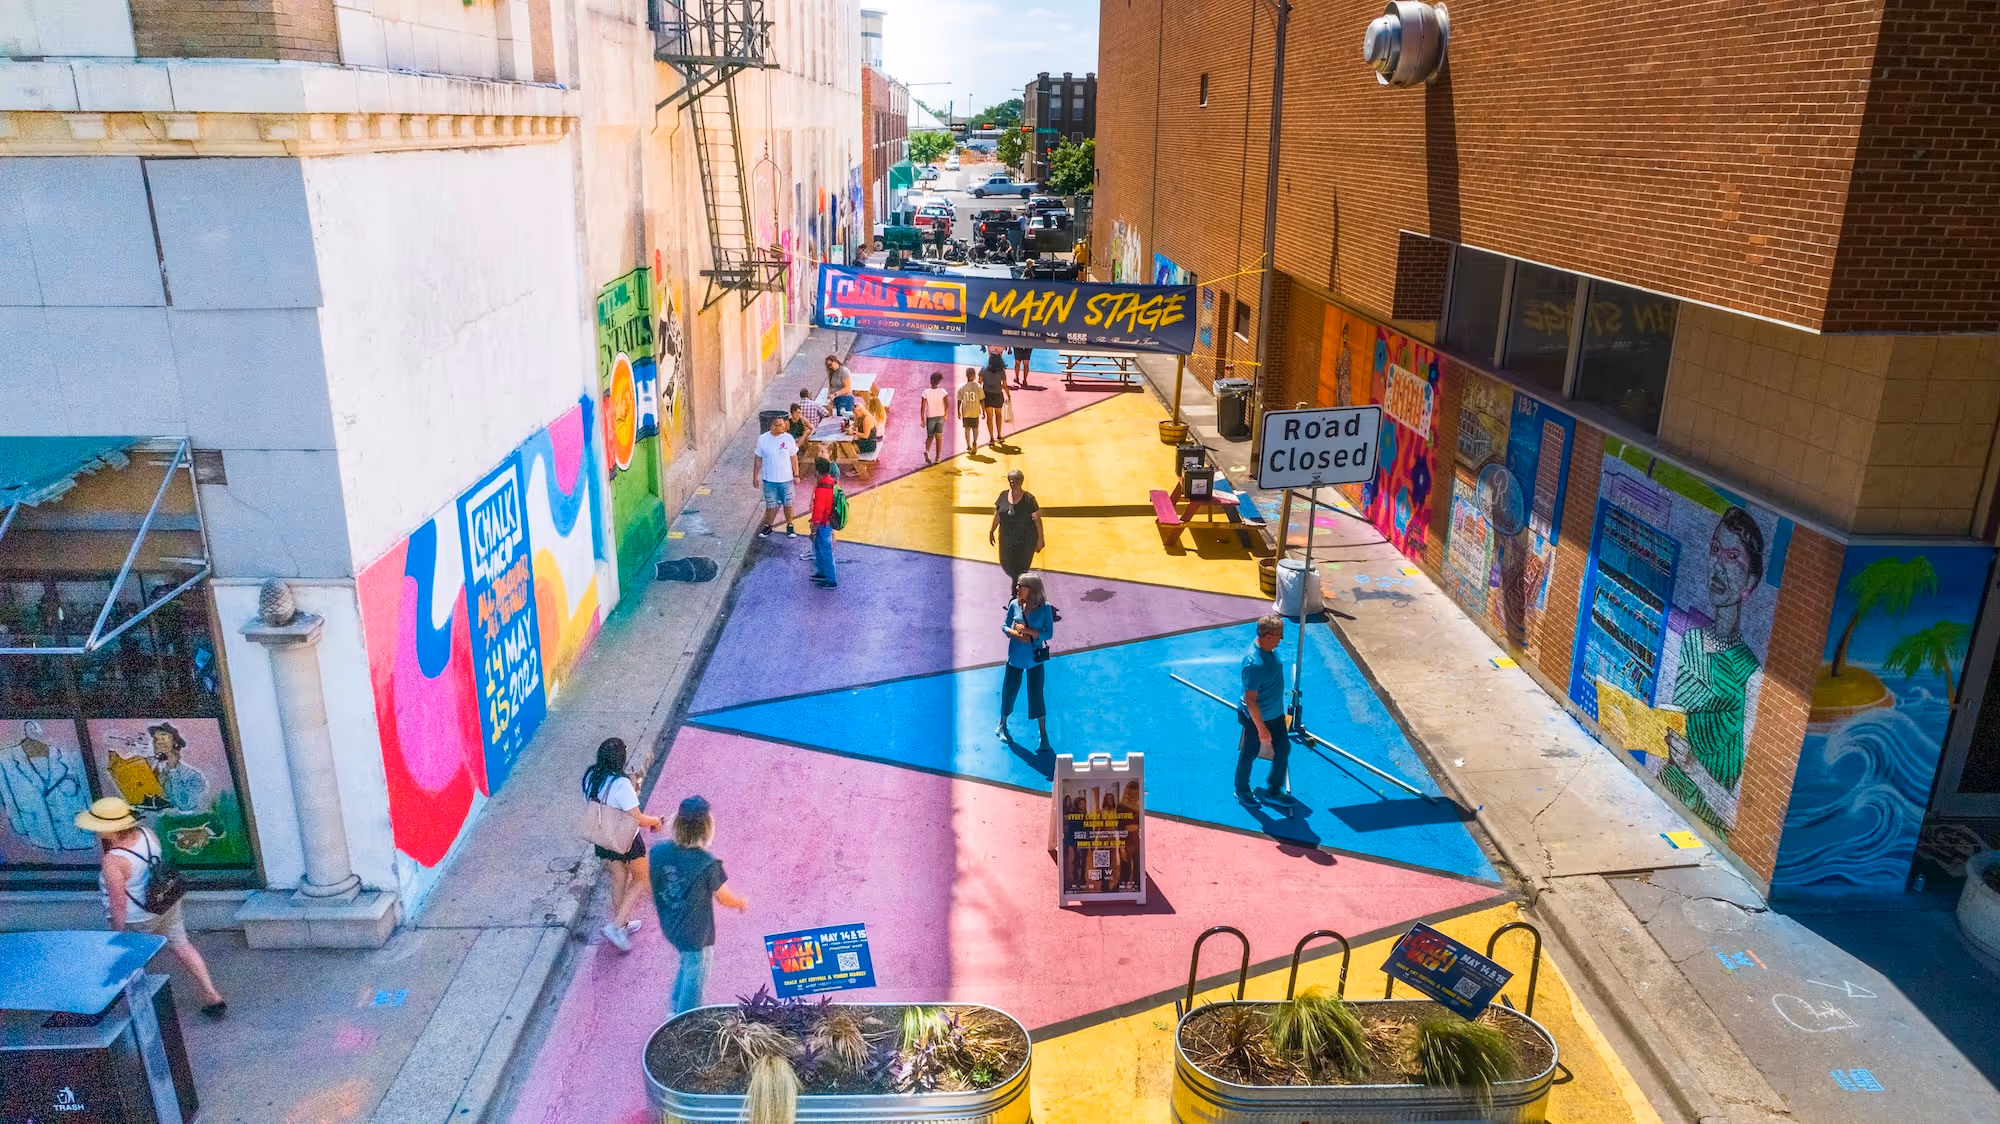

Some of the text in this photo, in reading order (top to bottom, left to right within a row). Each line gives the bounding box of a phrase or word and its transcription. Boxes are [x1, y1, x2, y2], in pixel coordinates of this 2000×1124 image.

[836, 280, 955, 311] CHALK WACO
[827, 316, 852, 326] 2022
[906, 322, 939, 330] FASHION
[980, 288, 1078, 328] MAIN
[1084, 292, 1186, 334] STAGE
[965, 391, 976, 401] 13
[1284, 413, 1360, 440] Road
[1269, 442, 1368, 472] Closed
[475, 486, 517, 558] CHALK
[484, 536, 513, 584] WACO
[485, 644, 504, 698] 14
[504, 608, 532, 672] MAY
[490, 686, 510, 744] 15
[509, 648, 539, 719] 2022
[774, 941, 814, 959] CHALK
[820, 933, 838, 943] MAY
[840, 931, 849, 940] 14
[857, 930, 867, 939] 15
[781, 956, 814, 973] WACO
[1460, 954, 1481, 968] MAY
[1481, 964, 1490, 975] 14
[1495, 973, 1507, 984] 15
